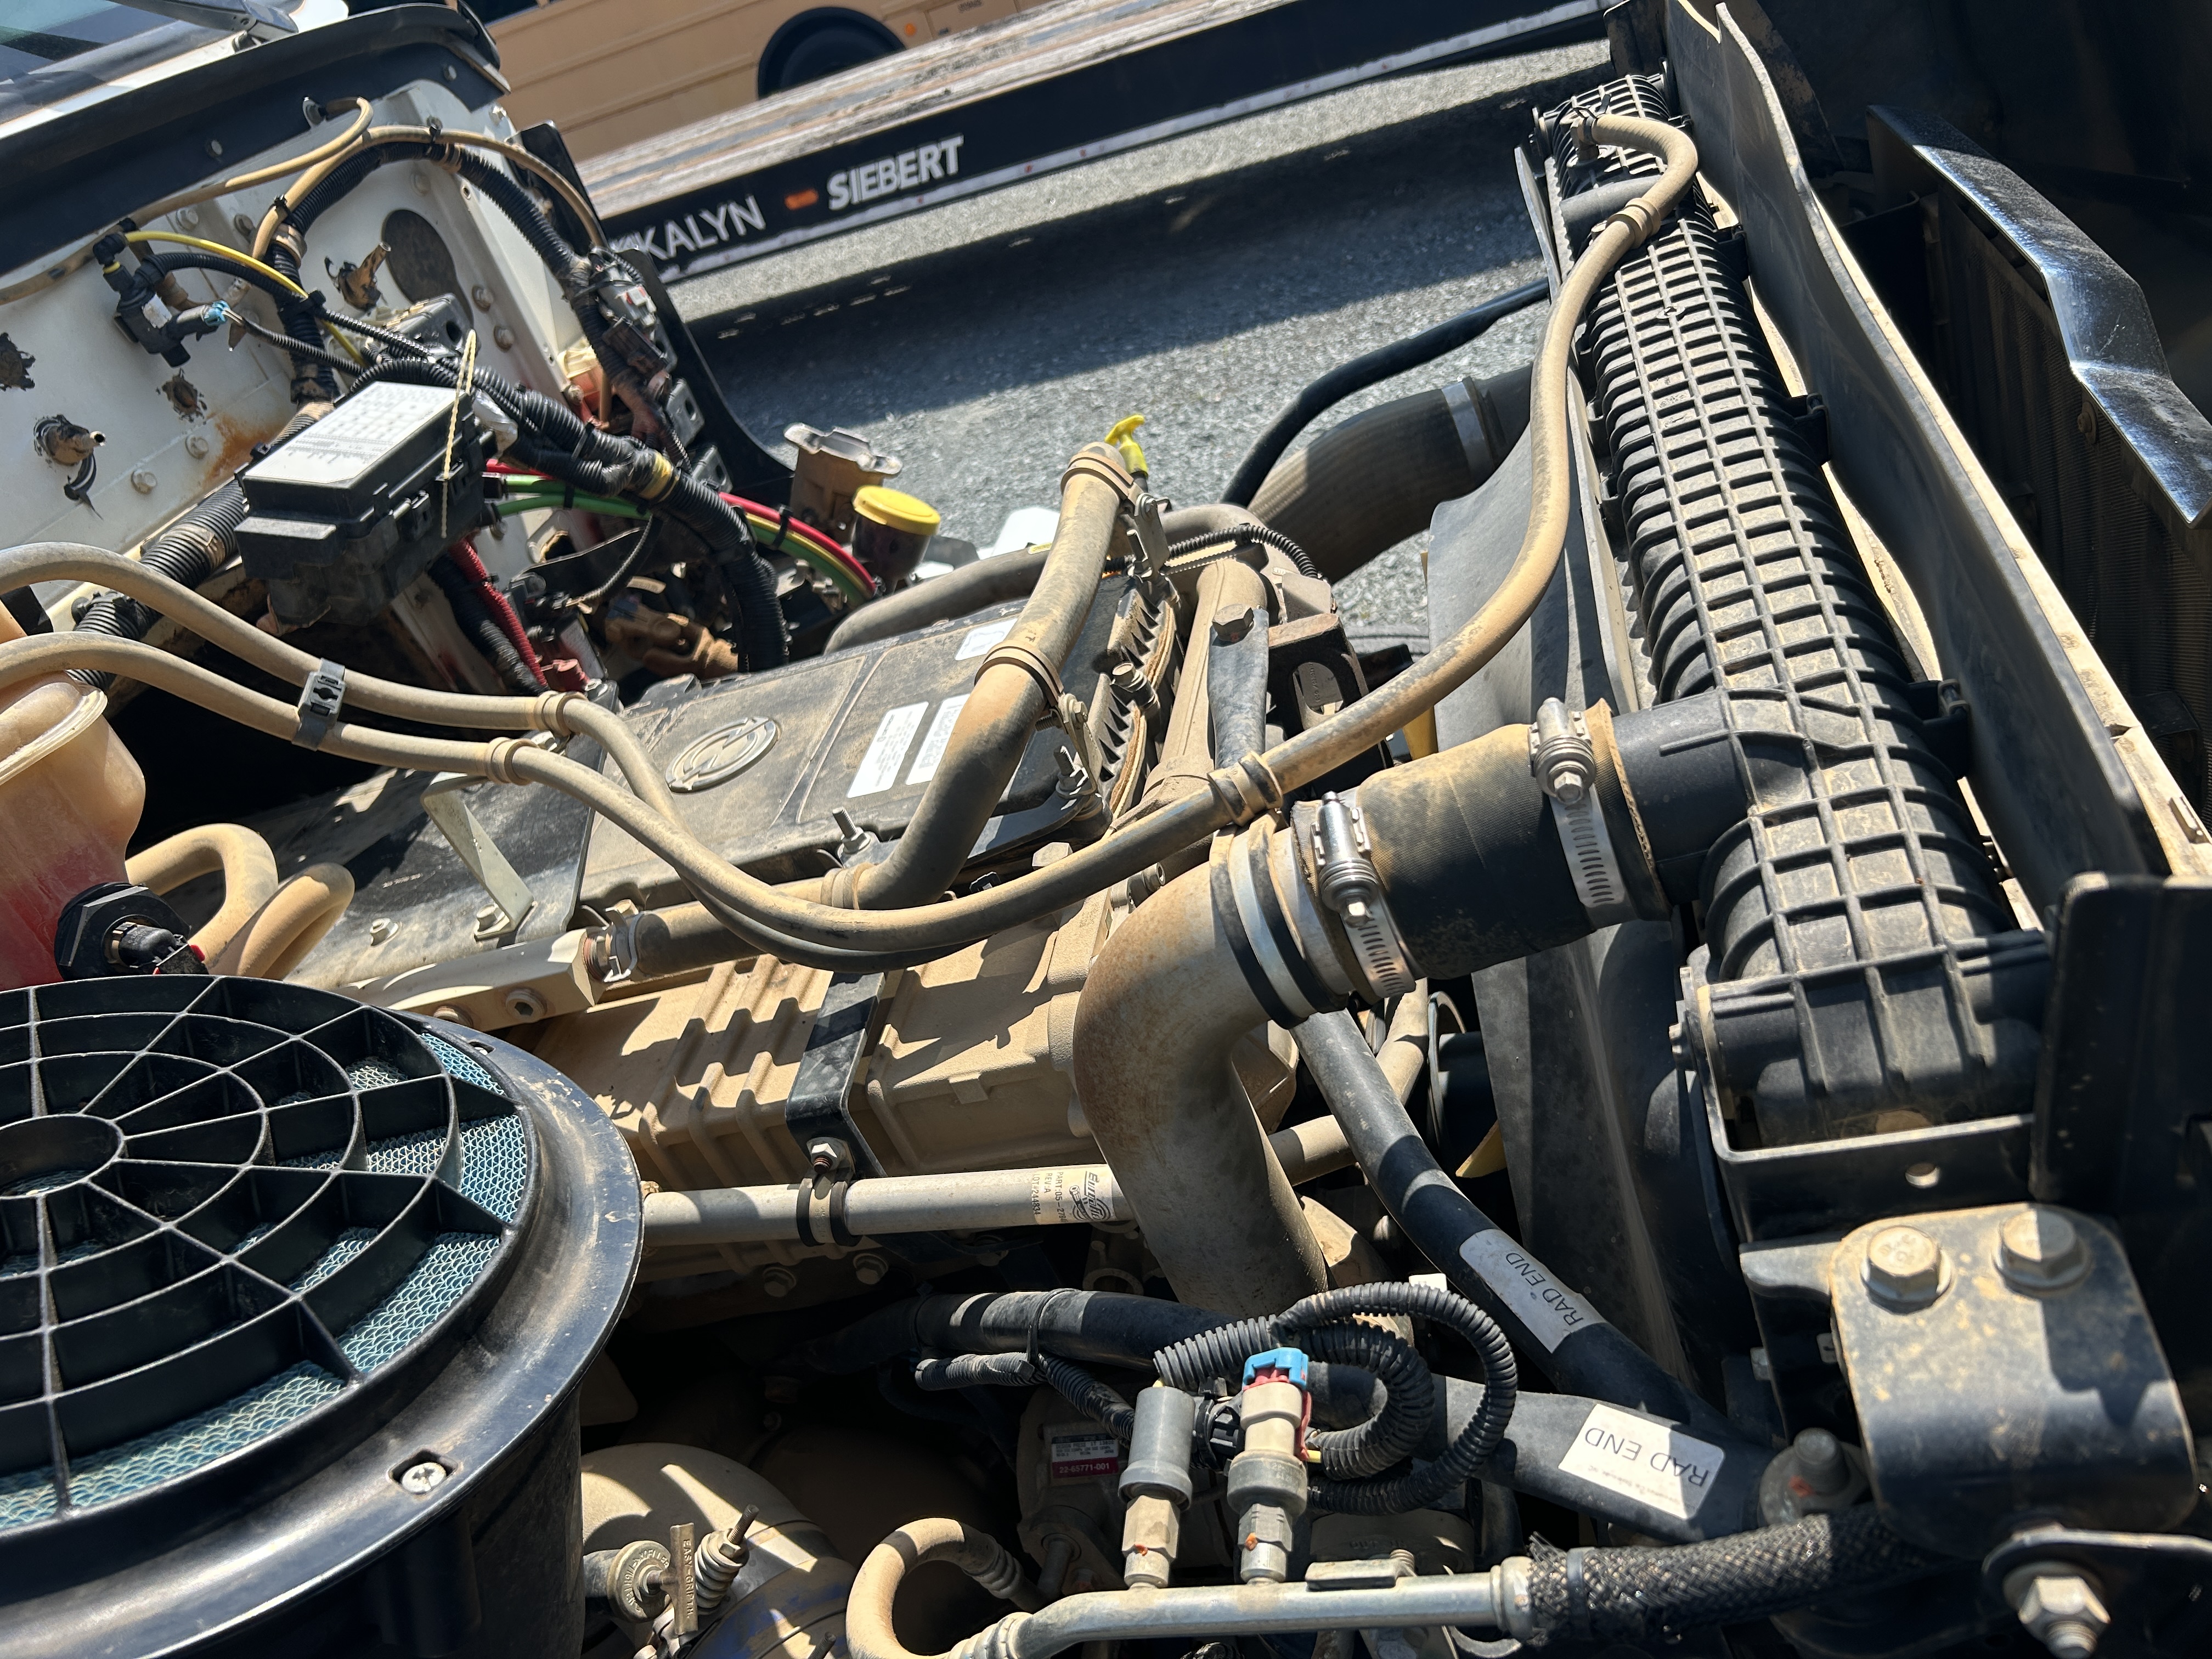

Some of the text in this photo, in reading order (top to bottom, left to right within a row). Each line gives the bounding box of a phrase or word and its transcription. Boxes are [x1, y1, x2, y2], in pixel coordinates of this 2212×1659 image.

[827, 134, 964, 211] SIEBERT
[635, 195, 766, 260] KALYN
[1044, 1173, 1053, 1193] REV:A
[1505, 1252, 1584, 1326] RAD END
[1059, 1462, 1109, 1474] 22-65771-001
[1584, 1427, 1710, 1487] RAD END
